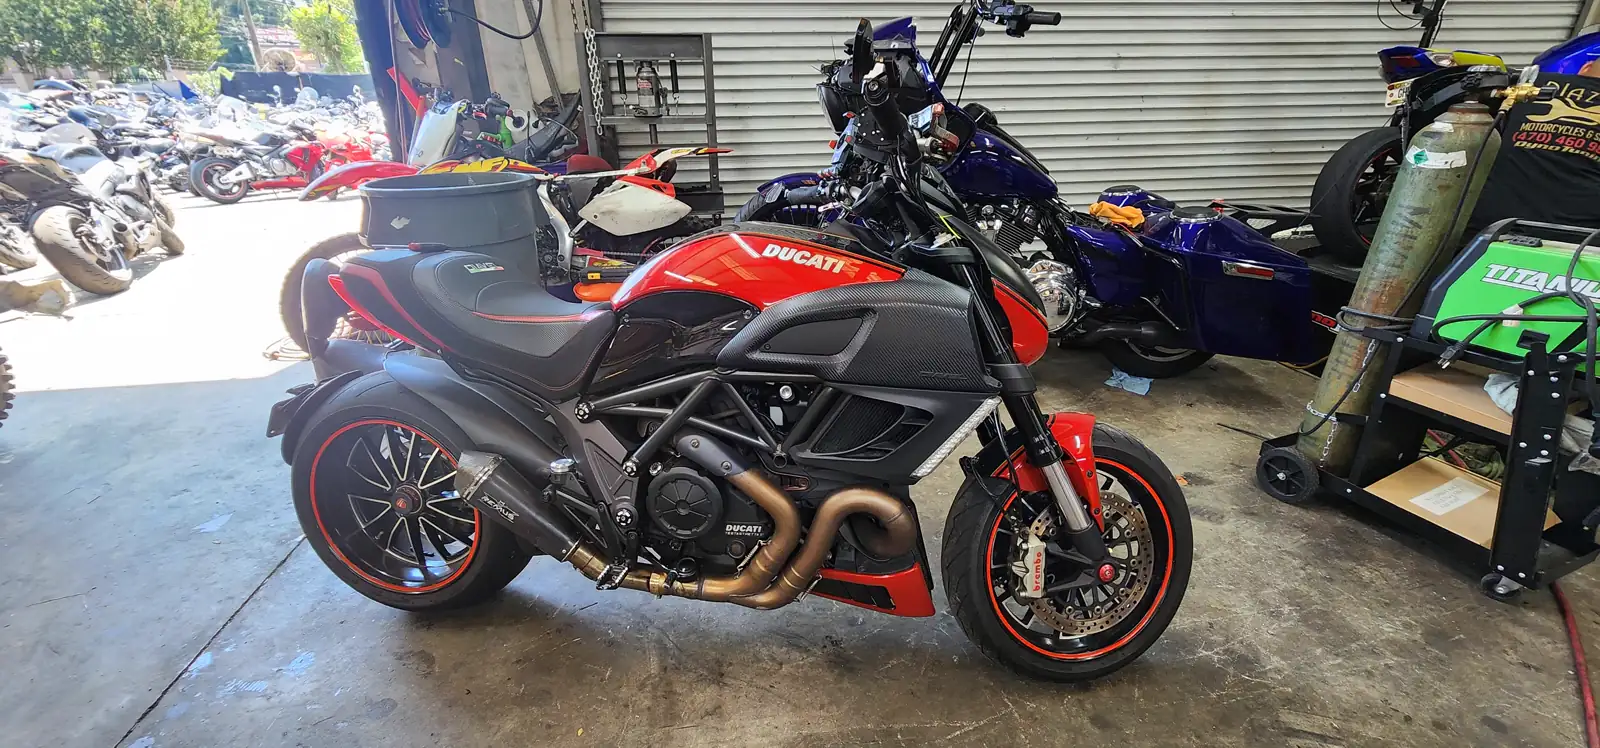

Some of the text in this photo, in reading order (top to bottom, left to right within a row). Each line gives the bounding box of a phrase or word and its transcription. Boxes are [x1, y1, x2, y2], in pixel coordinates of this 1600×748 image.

[1512, 131, 1552, 144] (470)
[1555, 135, 1587, 149] 460
[1520, 122, 1586, 137] MOTORCYCLES
[762, 243, 846, 274] DUCATI
[481, 495, 515, 521] REMUS
[725, 524, 762, 533] DUCATI
[1032, 551, 1042, 592] brembo
